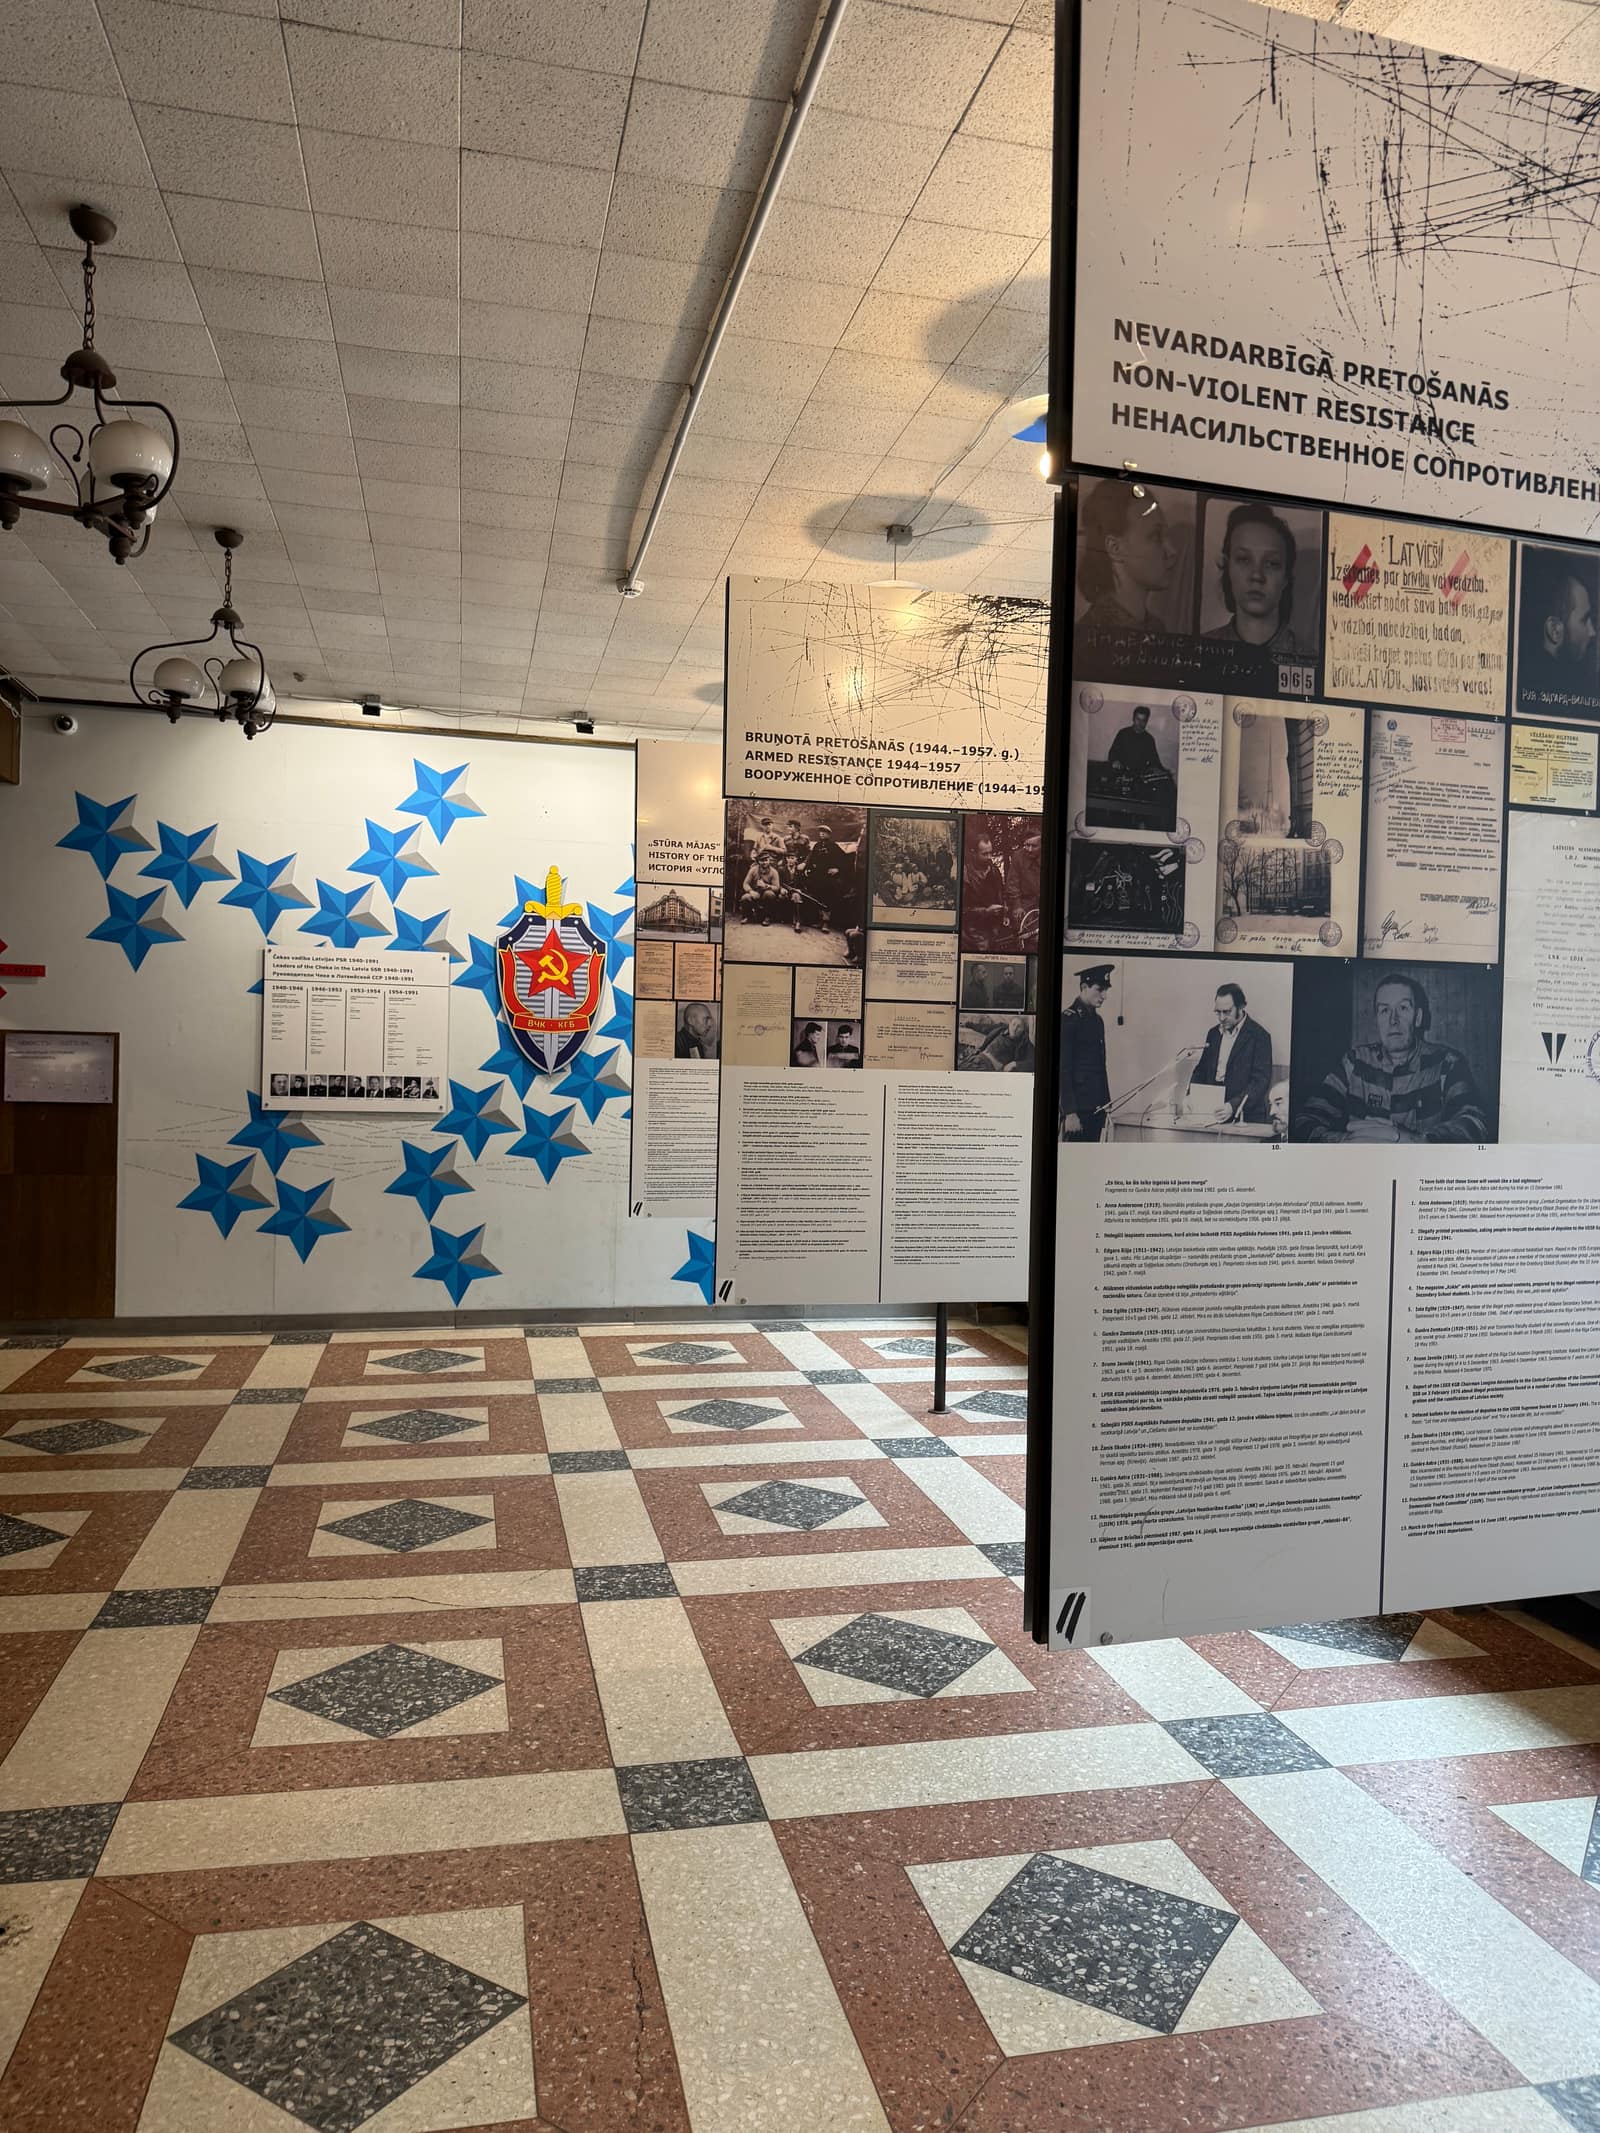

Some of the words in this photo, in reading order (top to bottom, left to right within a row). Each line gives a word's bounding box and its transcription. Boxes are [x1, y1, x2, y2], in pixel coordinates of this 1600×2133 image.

[1113, 317, 1334, 378] NEVARDARBĪGĀ
[1343, 362, 1510, 411] PRETOŠANĀS
[1113, 360, 1307, 415] NON-VIOLENT
[1316, 398, 1476, 445] RESISTANCE
[1112, 402, 1405, 472] НЕНАСИЛЬСТВЕННОЕ
[1414, 453, 1600, 502] СОПРОТИВЛЕН
[1279, 671, 1313, 690] 965
[745, 731, 811, 748] BRUŅOTĀ
[816, 735, 905, 752] PRETOŠANĀS
[1001, 747, 1020, 761] g.)
[745, 750, 793, 763] ARMED
[798, 754, 882, 769] RESISTANCE
[744, 768, 851, 785] ВООРУЖЕННОЕ
[855, 775, 974, 792] СОПРОТИВЛЕНИЕ
[648, 851, 690, 860] HISTORY
[707, 855, 724, 863] THE
[648, 863, 692, 872] ИСТОРИЯ
[527, 1020, 546, 1028] ВЧК
